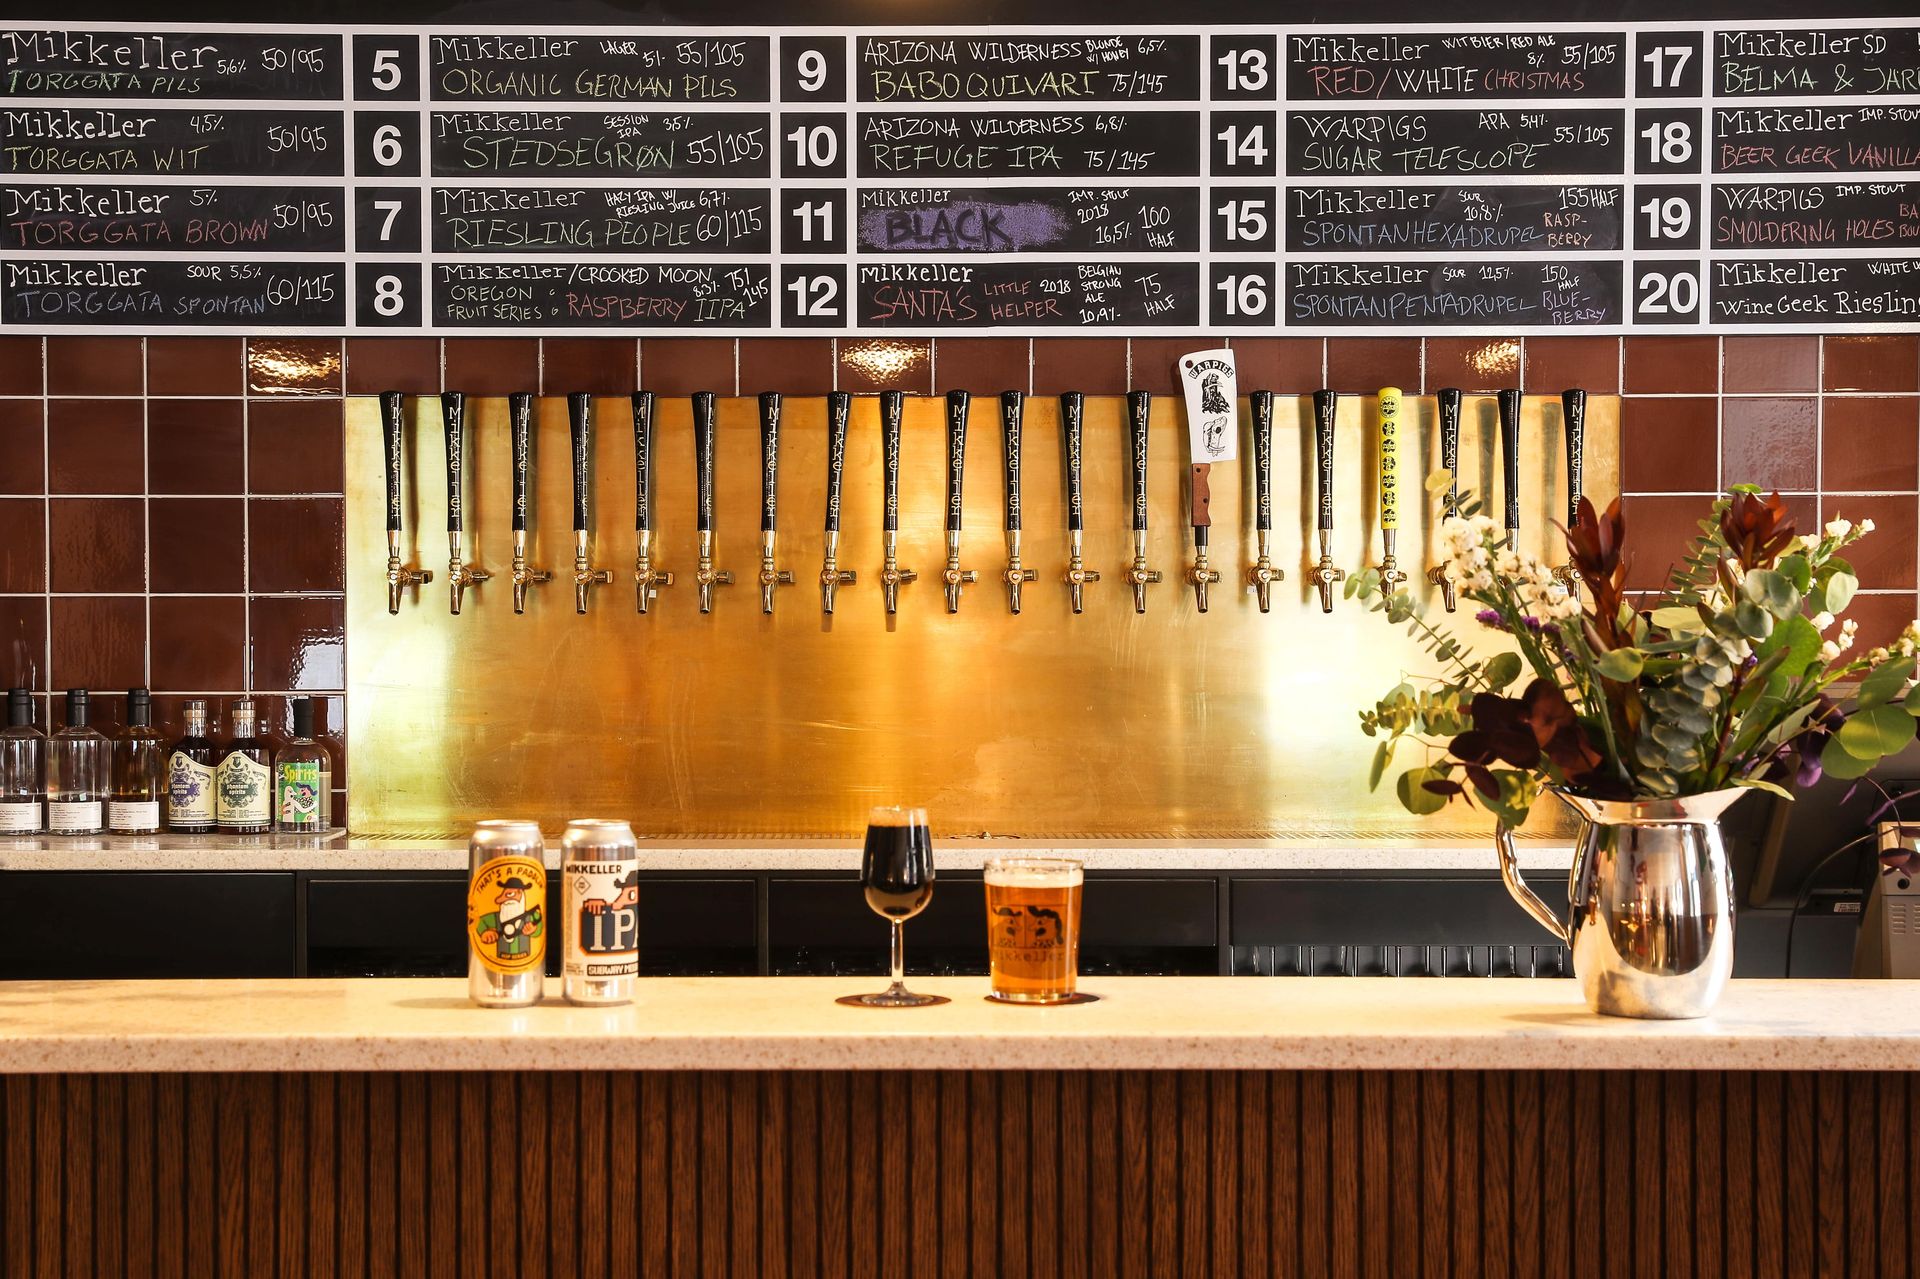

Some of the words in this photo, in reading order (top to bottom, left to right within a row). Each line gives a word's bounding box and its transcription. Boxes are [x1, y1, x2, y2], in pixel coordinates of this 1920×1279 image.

[2, 31, 218, 70] Mikkeller
[262, 47, 324, 73] 50/95
[433, 37, 579, 64] Mikkeller
[599, 40, 638, 55] LAGER
[676, 40, 746, 68] 55/105
[864, 38, 957, 65] ARIZONA
[968, 40, 1082, 64] WILDERNESS
[1101, 47, 1129, 62] HONEY
[1292, 36, 1430, 63] Mikkeller
[1537, 34, 1556, 47] ALE
[1561, 42, 1617, 70] 55/105
[1718, 31, 1859, 58] Mikkeller
[1863, 34, 1887, 54] SD
[8, 69, 141, 93] TORGGATA
[152, 76, 201, 93] PILS
[372, 50, 401, 91] 5
[797, 49, 827, 91] 9
[1218, 49, 1268, 91] 13
[1484, 68, 1585, 91] CHRISTMAS
[1643, 46, 1693, 88] 17
[1721, 61, 1818, 93] BELMA
[1834, 63, 1855, 92] &
[1864, 66, 1920, 93] JAR
[442, 69, 561, 97] ORGANIC
[575, 68, 672, 98] GERMAN
[683, 73, 738, 99] PILS
[1107, 70, 1168, 97] 75/145
[4, 110, 156, 139] Mikkeller
[267, 126, 327, 152] 50/95
[433, 112, 571, 137] Mikkeller
[604, 114, 649, 130] SESSION
[617, 127, 642, 139] IPA
[864, 117, 960, 141] ARIZONA
[970, 116, 1085, 135] WILDERNESS
[1293, 115, 1427, 142] WARPIGS
[1479, 112, 1510, 130] APA
[1717, 109, 1853, 137] Mikkeller
[1858, 107, 1887, 122] IMP.
[373, 124, 402, 167] 6
[464, 136, 674, 171] STEDSEGRØN
[686, 128, 763, 165] 55/105
[787, 125, 838, 167] 10
[1217, 124, 1268, 165] 14
[1302, 142, 1383, 173] SUGAR
[1392, 143, 1550, 173] TELESCOPE
[1553, 124, 1612, 146] 55/105
[1641, 121, 1692, 164] 18
[1721, 143, 1777, 170] BEER
[1785, 145, 1841, 169] GEEK
[5, 146, 138, 171] TORGGATA
[153, 145, 209, 171] WIT
[869, 143, 999, 171] REFUGE
[1006, 145, 1063, 170] IPA
[1084, 149, 1156, 172] 75/145
[6, 187, 170, 217] Mikkeller
[273, 200, 333, 233] 50/95
[436, 189, 586, 215] Mikkeller
[604, 191, 632, 206] HAZY
[634, 189, 656, 202] IPA
[616, 200, 665, 218] RIESLING
[669, 200, 696, 213] JUICE
[862, 188, 951, 208] Mikkeller
[1293, 189, 1436, 218] Mikkeller
[1458, 189, 1484, 203] SOUR
[1559, 187, 1588, 210] 155
[1590, 188, 1619, 209] HALF
[1717, 186, 1825, 212] WARPIGS
[1835, 184, 1865, 197] IMP.
[1868, 183, 1906, 196] STOUT
[374, 201, 402, 241] 7
[446, 217, 594, 248] RIESLING
[605, 218, 691, 247] PEOPLE
[696, 206, 762, 246] 60/115
[793, 201, 833, 241] 11
[885, 207, 1014, 247] BLACK
[1077, 203, 1109, 224] 2018
[1138, 205, 1170, 229] 100
[1217, 200, 1268, 241] 15
[1640, 197, 1691, 239] 19
[11, 220, 171, 246] TORGGATA
[186, 219, 268, 245] BROWN
[1147, 231, 1175, 248] HALF
[1303, 220, 1545, 249] SPONTANHEXADRUPEL
[1547, 232, 1593, 248] BERRY
[1717, 216, 1835, 244] SMOLDERING
[1846, 219, 1895, 241] HOLES
[6, 262, 147, 287] Mikkeller
[187, 265, 222, 281] SOUR
[266, 273, 335, 306] 60/115
[659, 266, 712, 284] MOON
[861, 264, 974, 284] Mikkeller
[1078, 265, 1122, 279] BELGIAN
[984, 280, 1031, 296] LITTLE
[1039, 279, 1072, 295] 2018
[1081, 278, 1122, 291] STRONG
[1135, 272, 1161, 297] 75
[1292, 263, 1429, 288] Mikkeller
[1442, 266, 1467, 281] SOUR
[1541, 264, 1568, 283] 150
[1558, 275, 1580, 291] HALF
[1717, 262, 1847, 287] Mikkeller
[1868, 261, 1910, 275] WHITE
[17, 290, 163, 318] TORGGATA
[173, 294, 266, 315] SPONTAN
[374, 275, 404, 316] 8
[451, 285, 532, 301] OREGON
[787, 275, 838, 316] 12
[870, 285, 978, 321] SANTA'S
[1085, 292, 1105, 303] ALE
[1144, 294, 1175, 317] HALF
[1217, 274, 1267, 316] 16
[1293, 291, 1537, 319] SPONTANPENTADRUPEL
[1638, 271, 1699, 314] 20
[447, 304, 488, 320] FRUIT
[493, 304, 542, 321] SERIES
[566, 292, 688, 322] RASPBERRY
[990, 298, 1063, 320] HELPER
[1552, 308, 1606, 325] BERRY
[1188, 360, 1234, 379] WARPIGS
